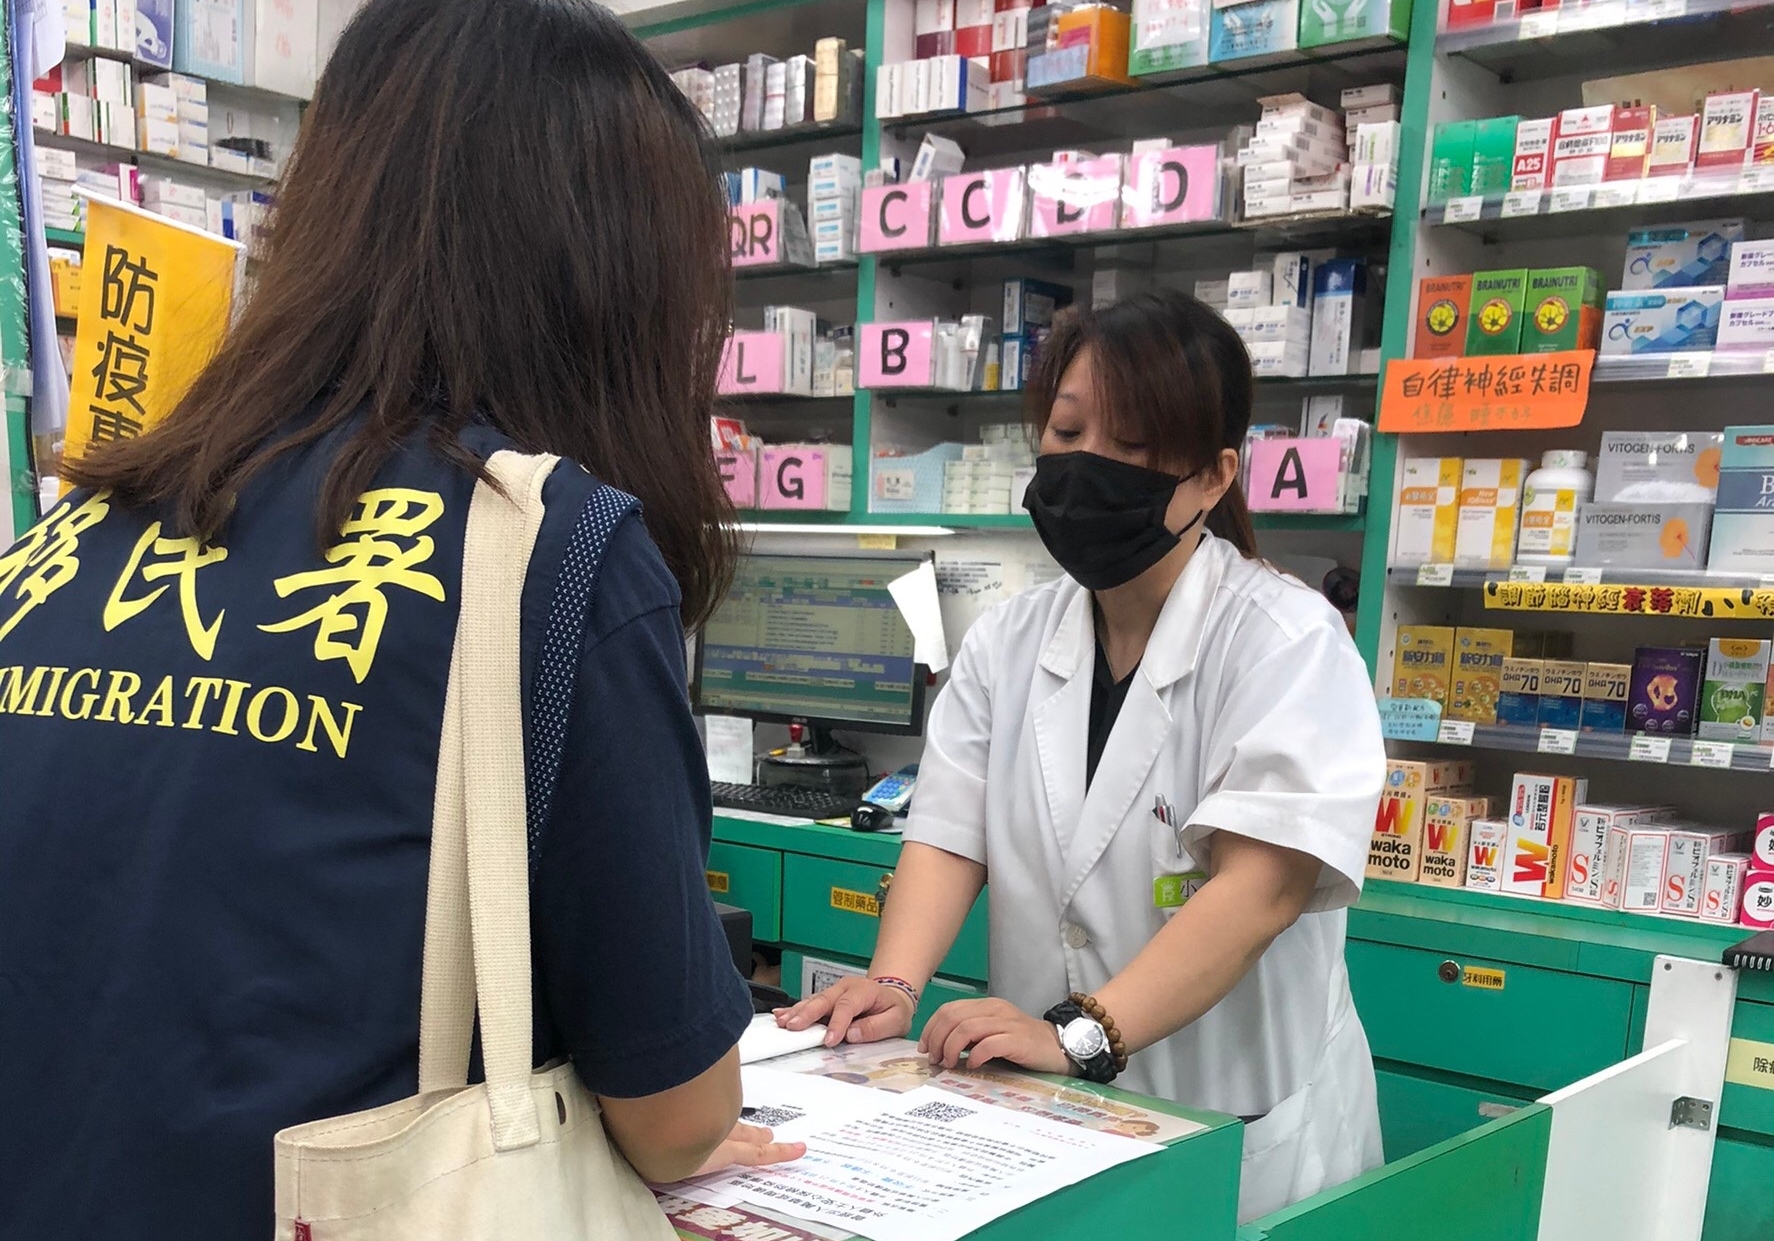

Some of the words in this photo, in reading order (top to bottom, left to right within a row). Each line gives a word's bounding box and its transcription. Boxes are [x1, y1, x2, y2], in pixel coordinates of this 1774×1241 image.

[1516, 157, 1542, 173] A25
[1152, 160, 1189, 213] D
[879, 190, 908, 237] C
[961, 179, 991, 229] C
[1426, 281, 1465, 294] BRAINUTRI
[1477, 278, 1521, 292] BRAINUTRI
[1532, 275, 1578, 289] BRAINUTRI
[736, 342, 757, 385] L
[881, 328, 910, 375] B
[1402, 363, 1581, 400] 自律神經失調
[777, 457, 804, 500] G
[1271, 447, 1309, 499] A
[1586, 513, 1661, 525] VITOGEN-FORTIS
[0, 487, 446, 684] 移民署
[1521, 675, 1539, 691] 70
[1562, 678, 1582, 694] 70
[1607, 681, 1627, 698] 70
[0, 666, 363, 758] MIGRATION
[1371, 840, 1412, 855] waka
[1368, 854, 1411, 870] moto
[1423, 865, 1455, 878] moto
[1425, 855, 1456, 867] waka
[1549, 844, 1559, 884] wakamoto
[1570, 853, 1590, 885] S
[1666, 874, 1686, 902] S
[1706, 890, 1721, 911] S
[832, 889, 879, 914] 管制藥品
